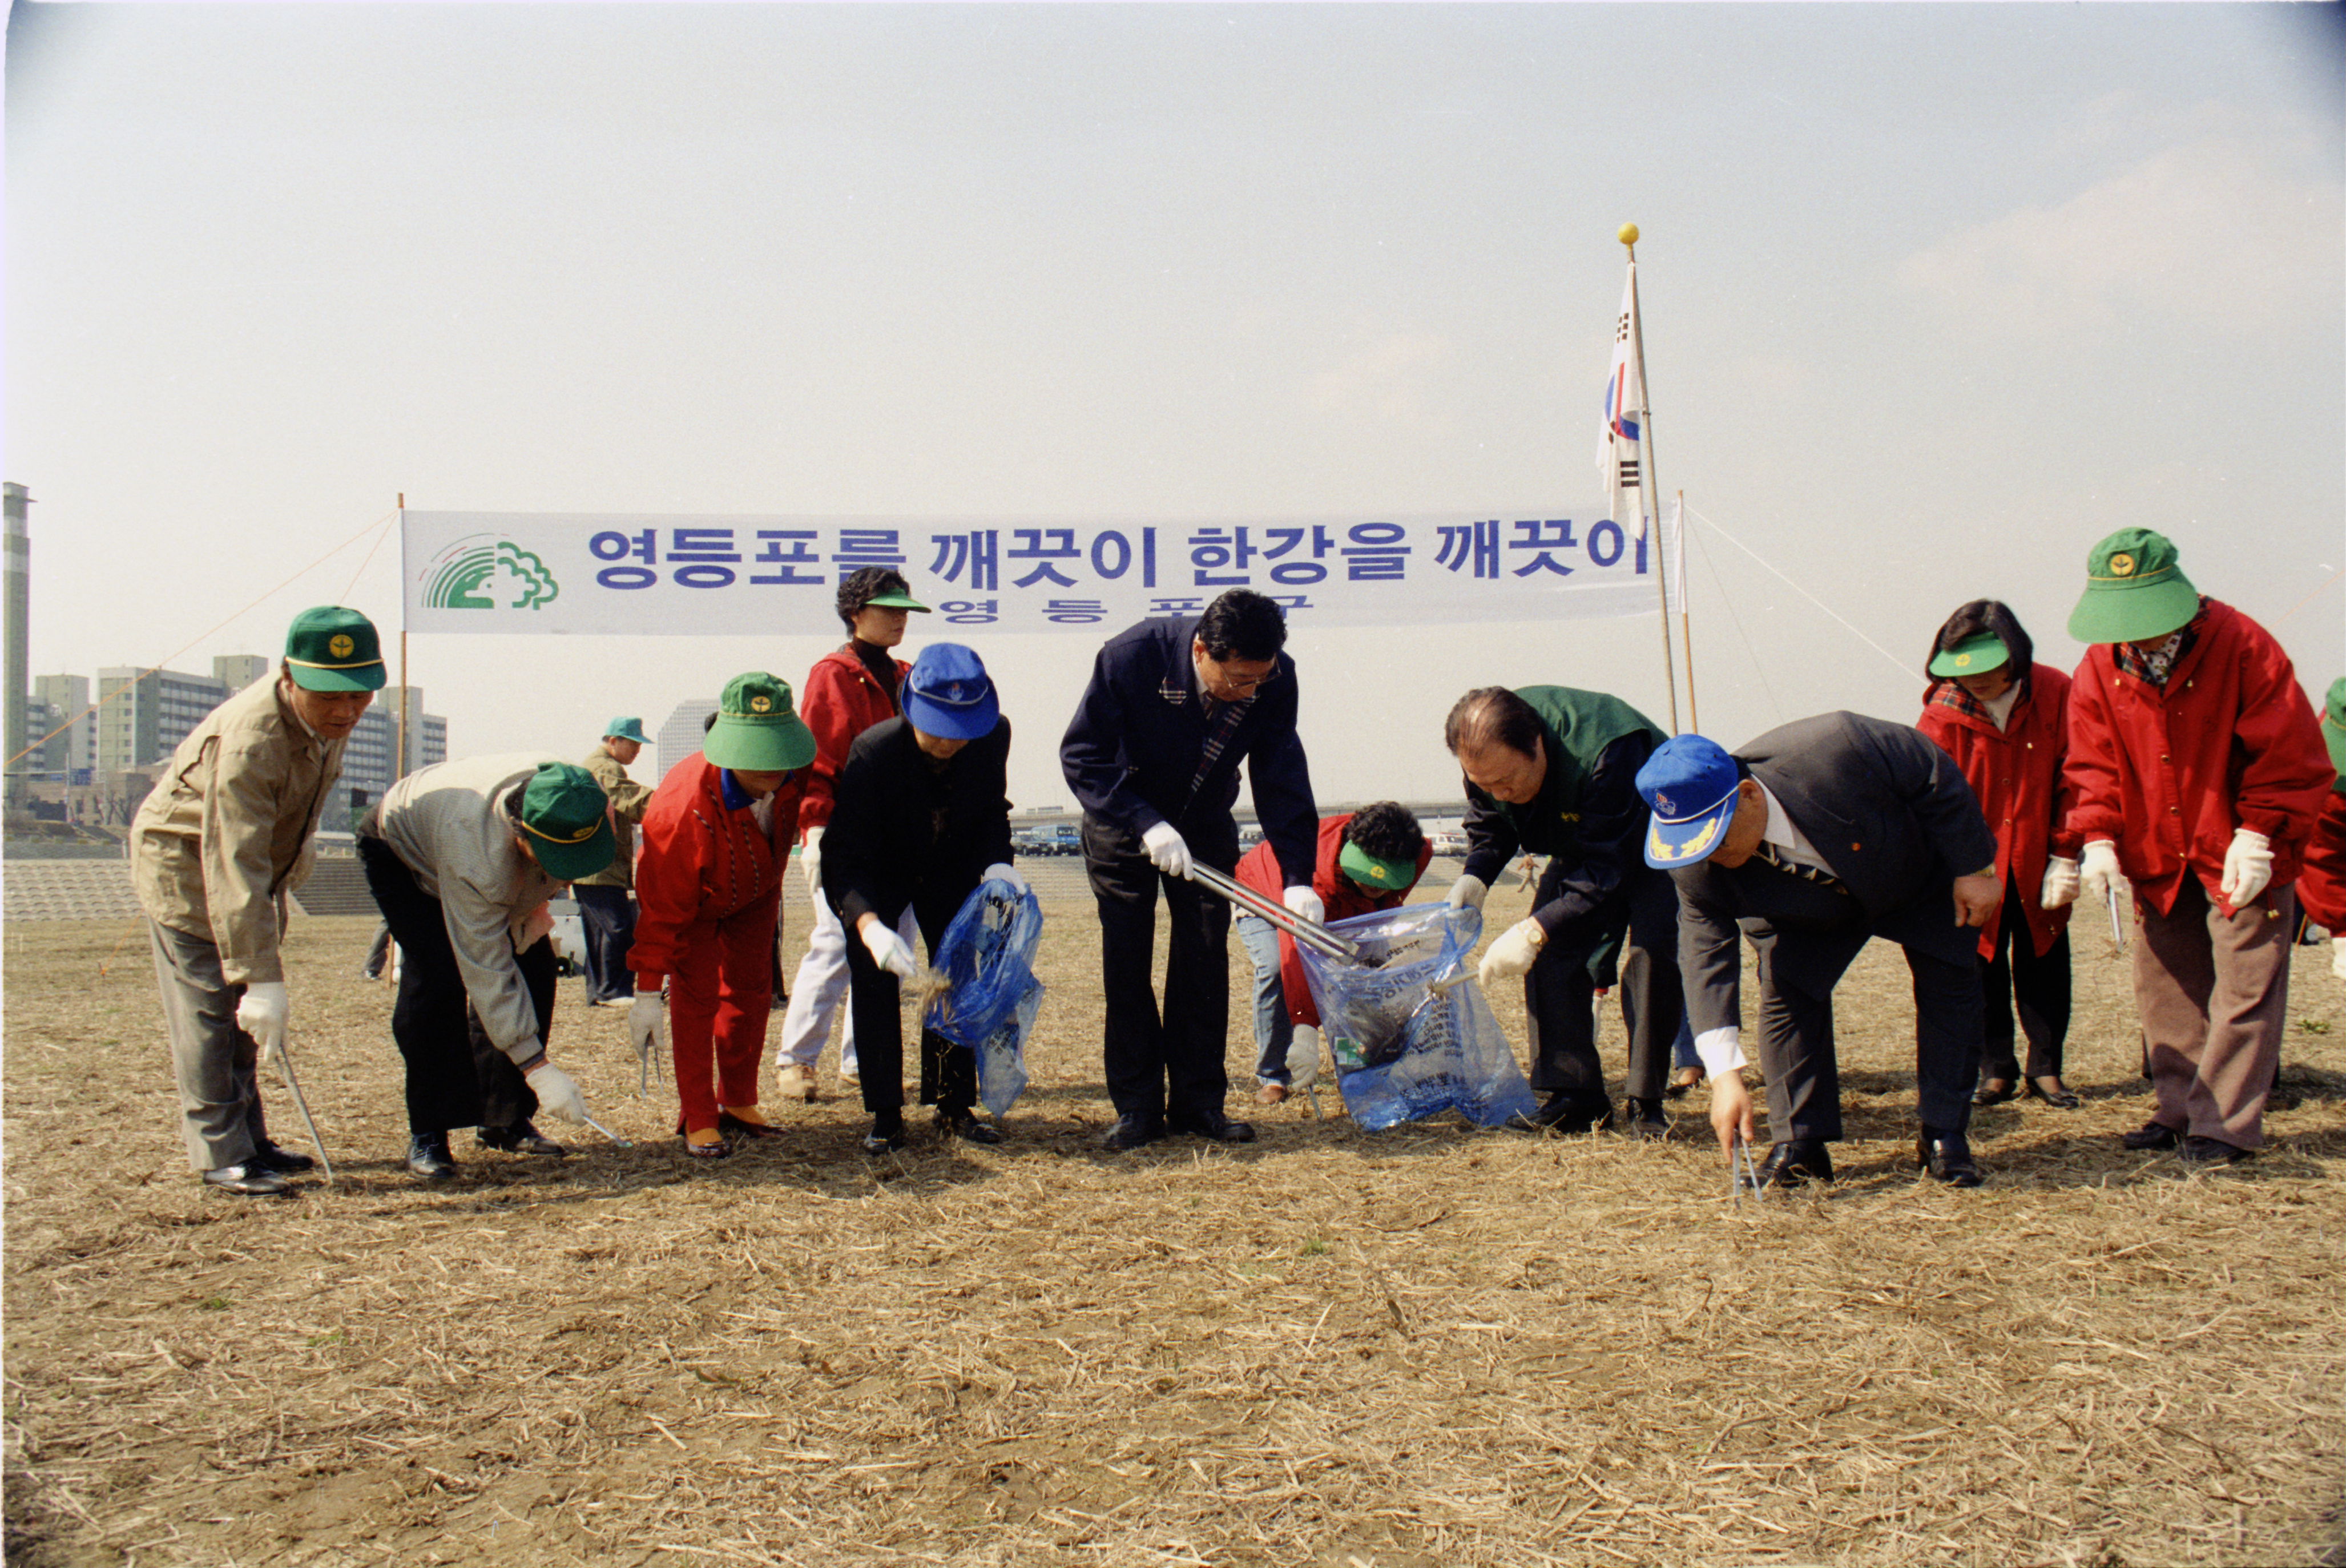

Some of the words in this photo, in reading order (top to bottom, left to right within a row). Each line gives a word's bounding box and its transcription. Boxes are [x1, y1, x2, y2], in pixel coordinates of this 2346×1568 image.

[589, 528, 906, 590] 영등포를
[929, 526, 1156, 591] 깨끗이
[1188, 522, 1412, 587] 한강을
[1434, 515, 1649, 579] 깨끗이
